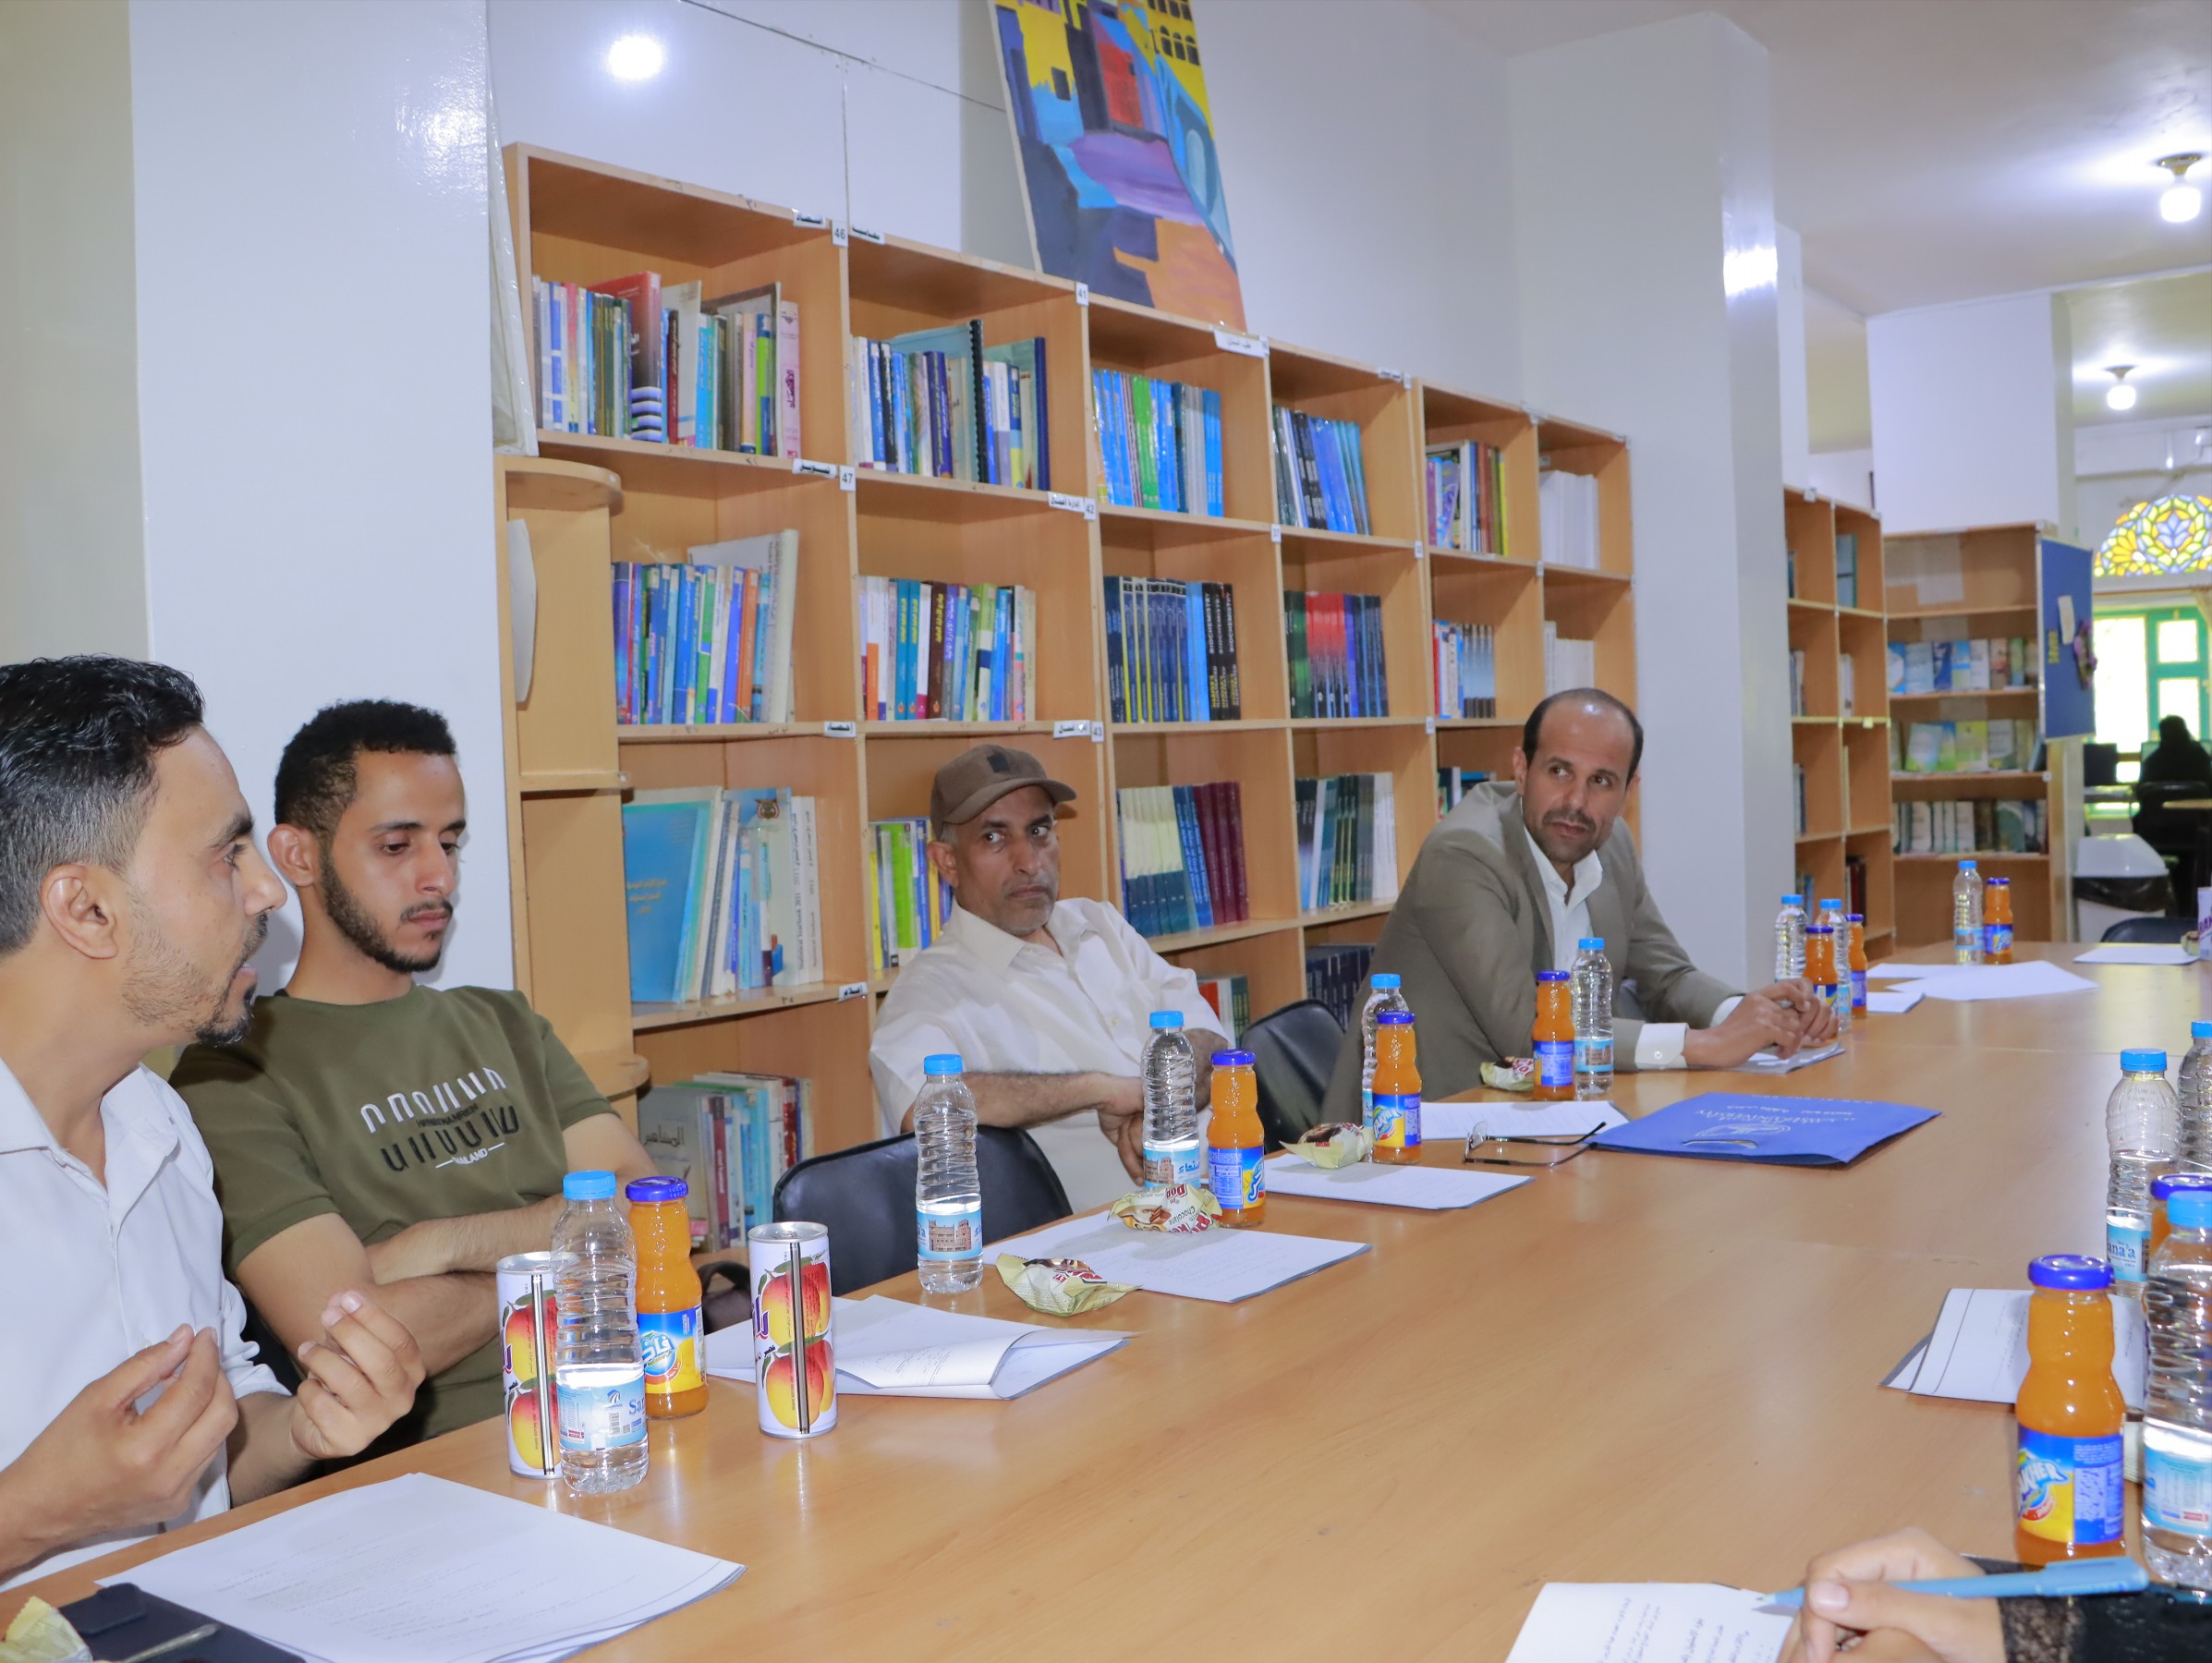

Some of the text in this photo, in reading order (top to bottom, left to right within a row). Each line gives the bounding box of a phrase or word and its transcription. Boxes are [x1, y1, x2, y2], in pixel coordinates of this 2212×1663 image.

[834, 227, 846, 240] 46
[842, 472, 854, 485] 47
[1086, 504, 1095, 514] 42
[1205, 592, 1214, 653] BIOCHEMISTRY
[1226, 592, 1235, 652] BIOCHEMISTRY
[1093, 726, 1102, 736] 43
